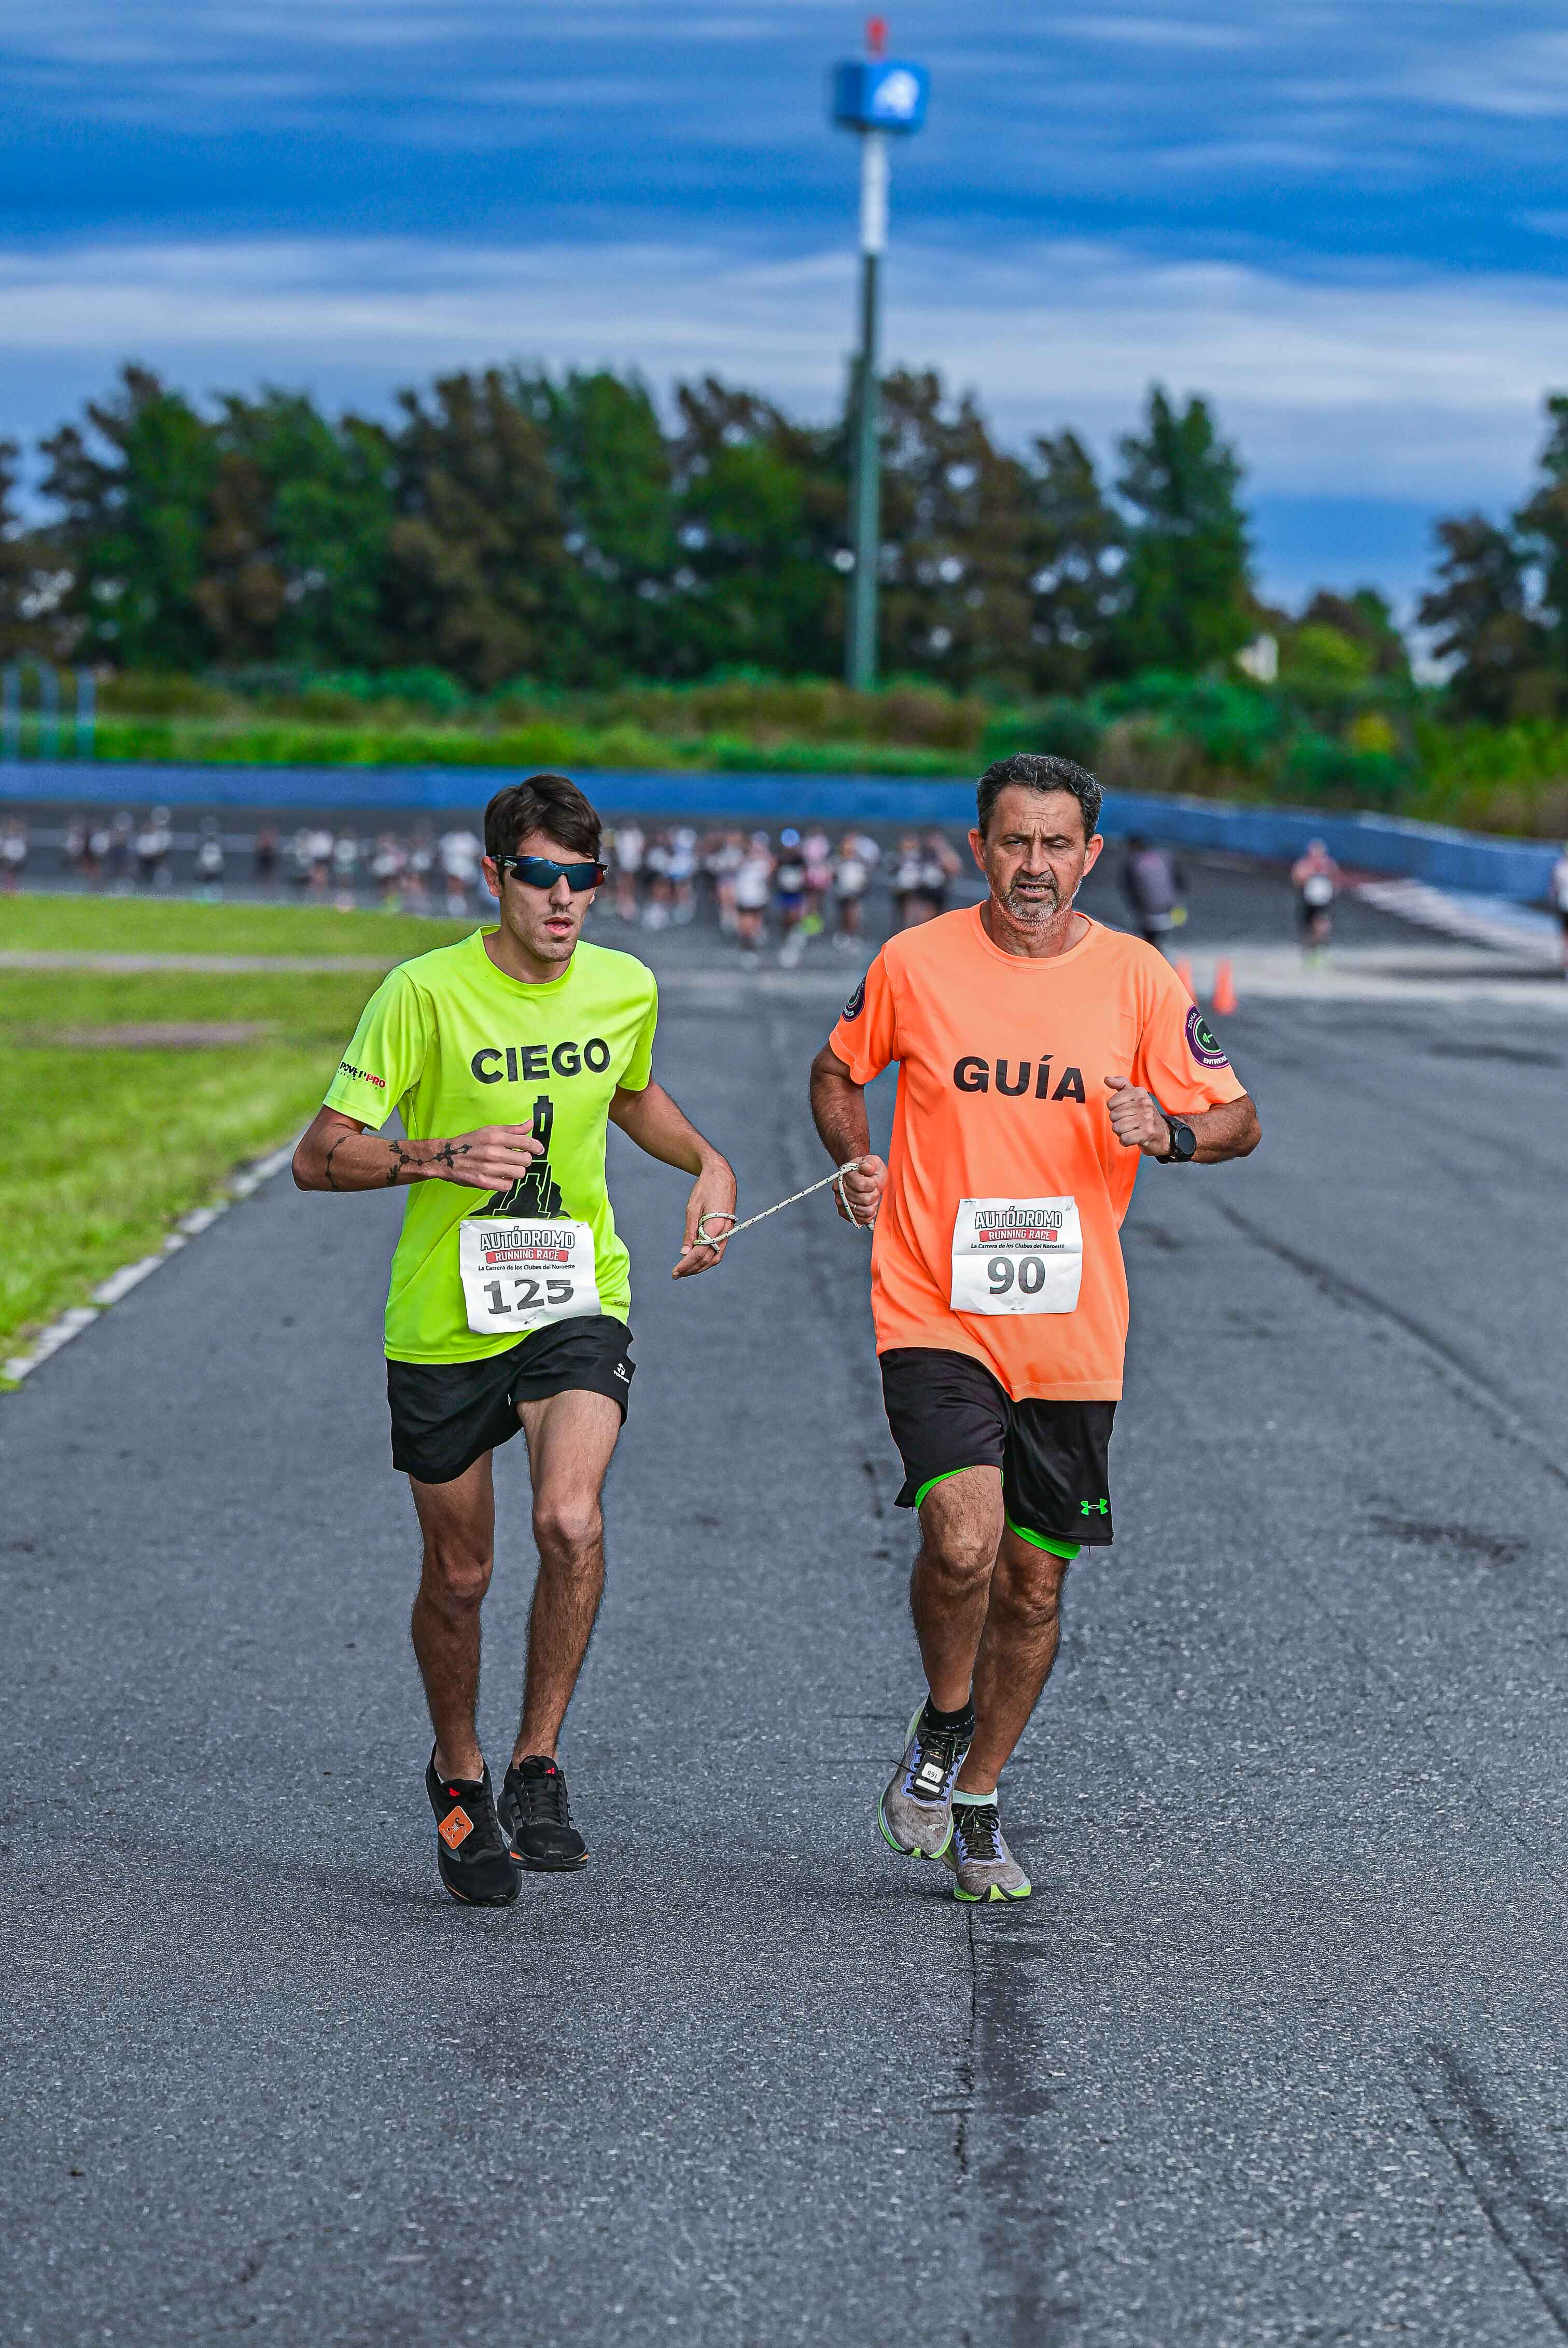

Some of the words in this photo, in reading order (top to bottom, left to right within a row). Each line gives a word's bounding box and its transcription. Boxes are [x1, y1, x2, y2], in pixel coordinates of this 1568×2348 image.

[1188, 1012, 1197, 1029] ZONA
[471, 1038, 610, 1084] CIEGO
[953, 1054, 1086, 1103] GUÍA
[975, 1206, 1062, 1229] AUTÓDROMO
[480, 1226, 575, 1251] AUTÓDROMO
[989, 1229, 1027, 1240] RUNNING
[1029, 1231, 1051, 1240] RACE
[495, 1250, 534, 1262] RUNNING
[537, 1250, 559, 1260] RACE
[987, 1256, 1045, 1294] 90
[483, 1279, 574, 1315] 125
[927, 1770, 938, 1779] 168
